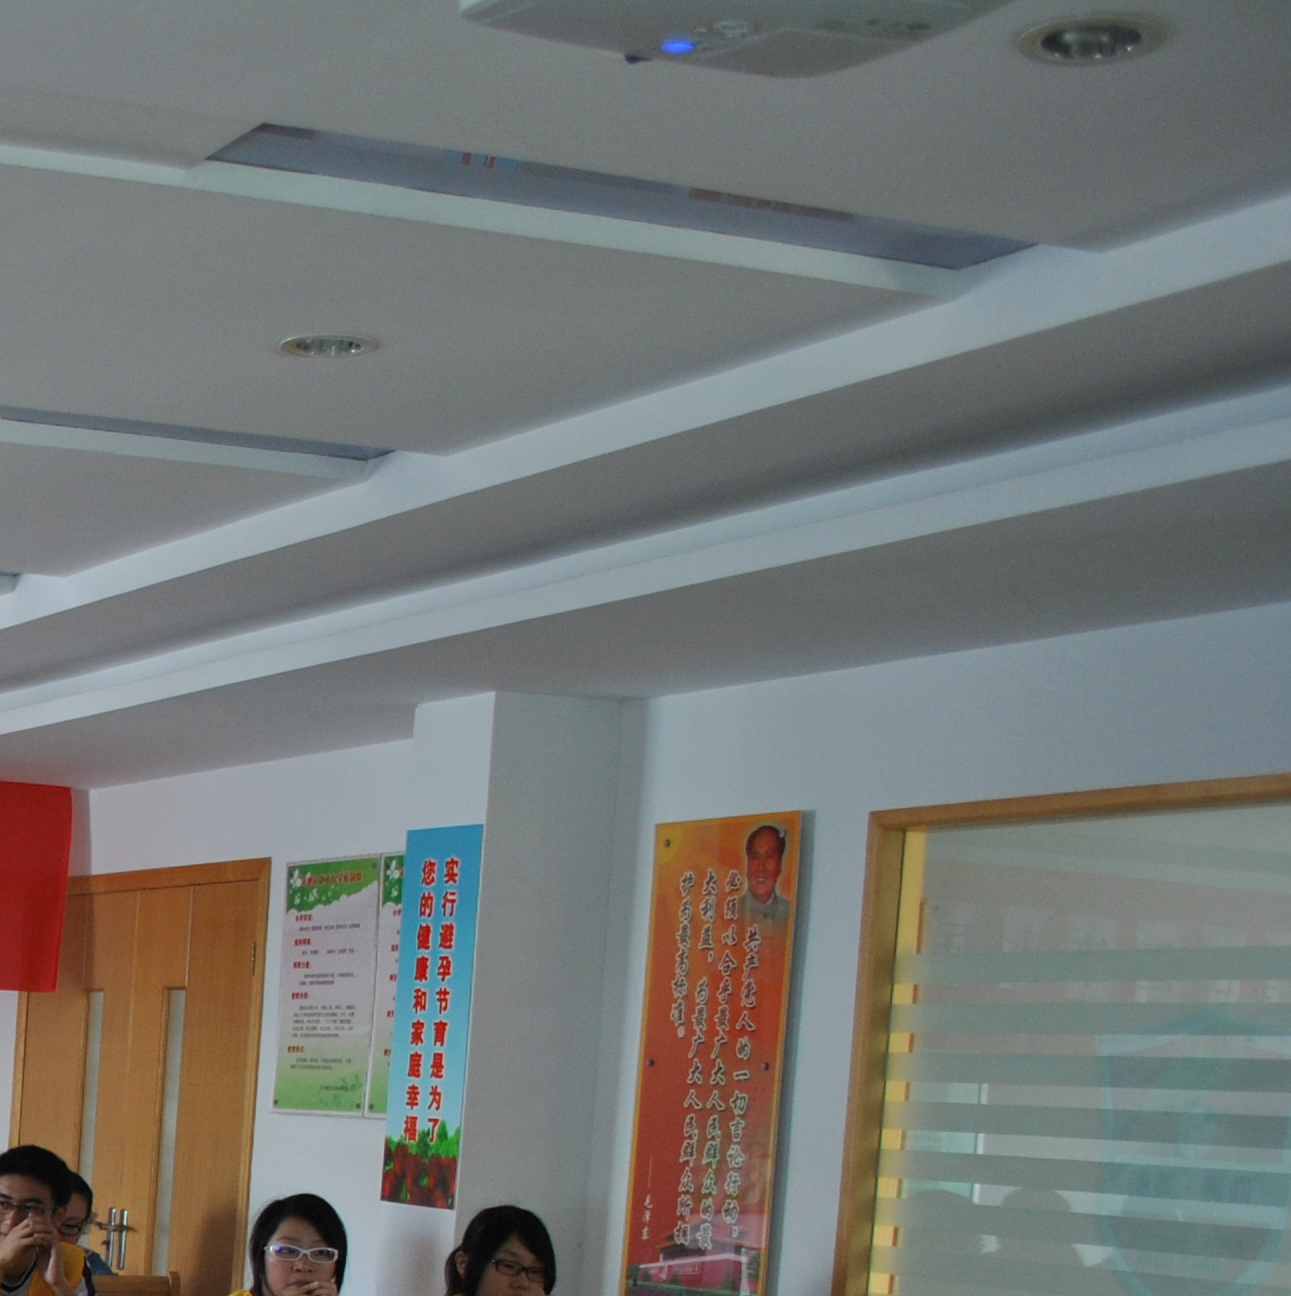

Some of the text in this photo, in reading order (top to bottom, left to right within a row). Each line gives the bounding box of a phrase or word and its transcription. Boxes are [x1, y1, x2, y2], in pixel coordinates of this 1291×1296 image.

[403, 858, 437, 1142] 您的健康和家庭幸福
[427, 857, 460, 1143] 实行避孕节育是为了
